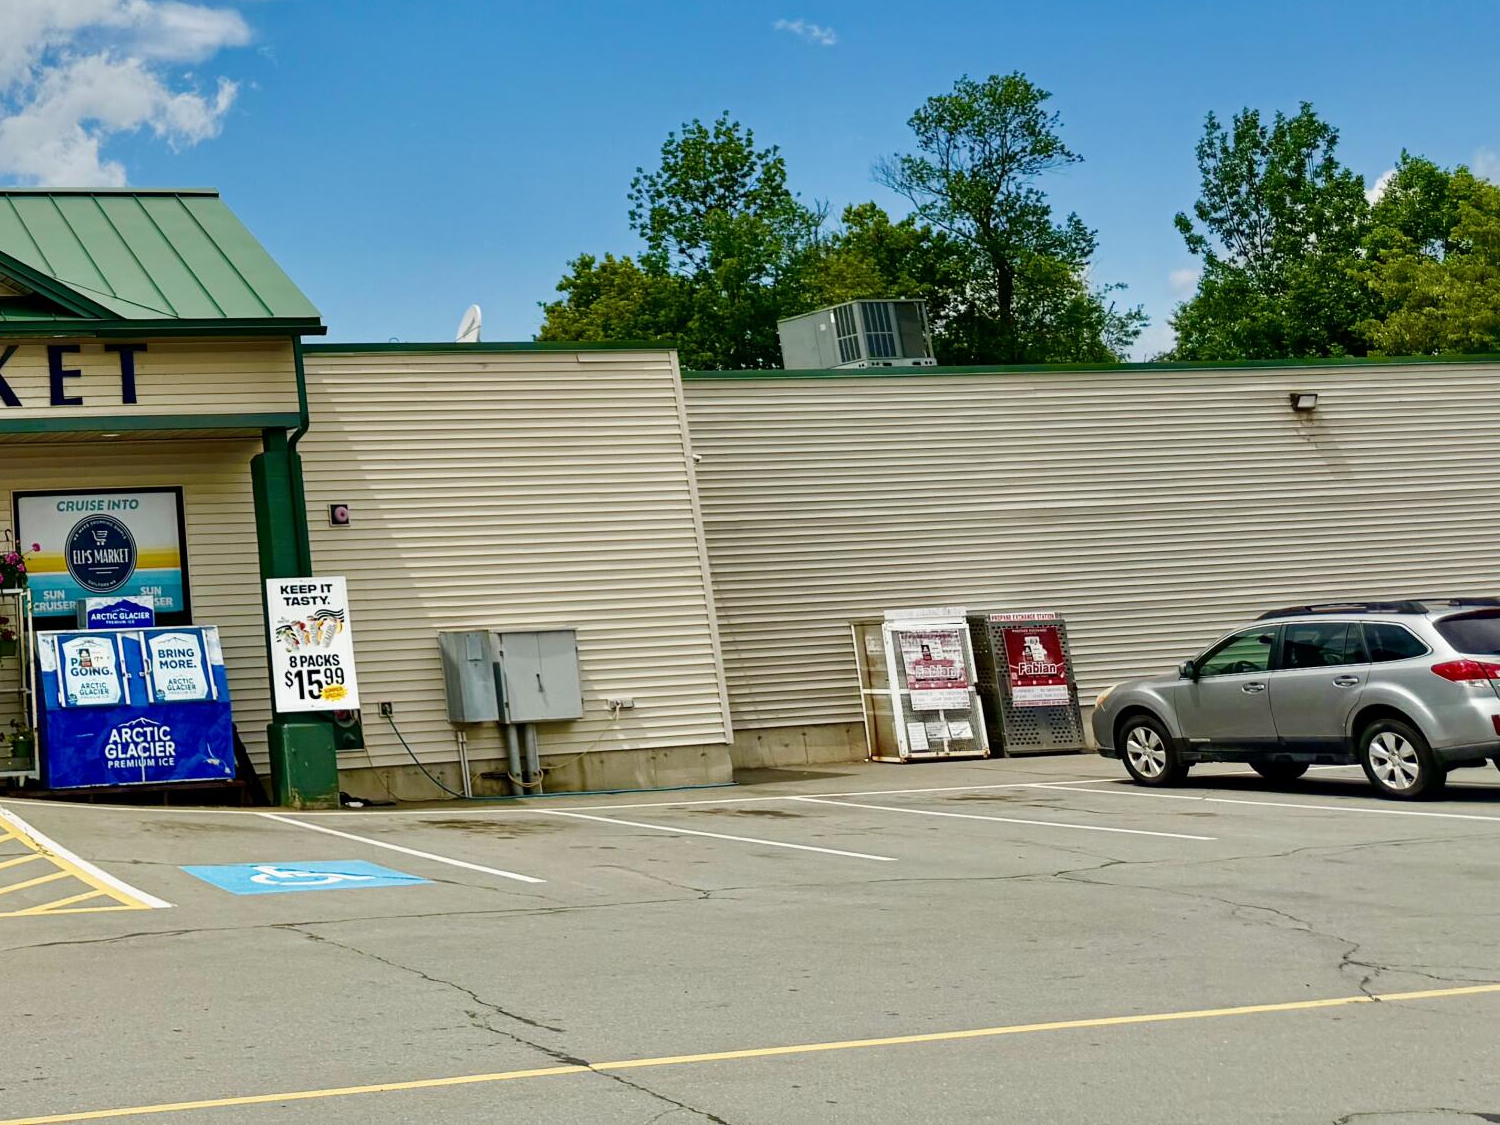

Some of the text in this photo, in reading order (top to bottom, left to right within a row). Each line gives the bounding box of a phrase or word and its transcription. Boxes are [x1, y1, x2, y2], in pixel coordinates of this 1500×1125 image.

[56, 499, 139, 512] CRUISE INTO
[73, 548, 130, 565] ELI'S MARKET
[43, 589, 65, 600] SUN
[140, 586, 161, 596] SUN
[280, 583, 332, 595] KEEP IT
[33, 600, 76, 612] CRUISER
[283, 596, 331, 606] TASTY.
[91, 611, 150, 621] ARCTIC GLACIER
[158, 648, 195, 659] BRING
[159, 659, 197, 669] MORE.
[289, 654, 340, 668] 8 PACKS
[70, 666, 113, 676] GOING.
[1018, 661, 1058, 676] Fabian
[167, 683, 197, 691] GLACIER
[109, 726, 171, 744] ARCTIC
[105, 742, 176, 759] GLACIER
[108, 757, 175, 769] PREMIUM ICE
